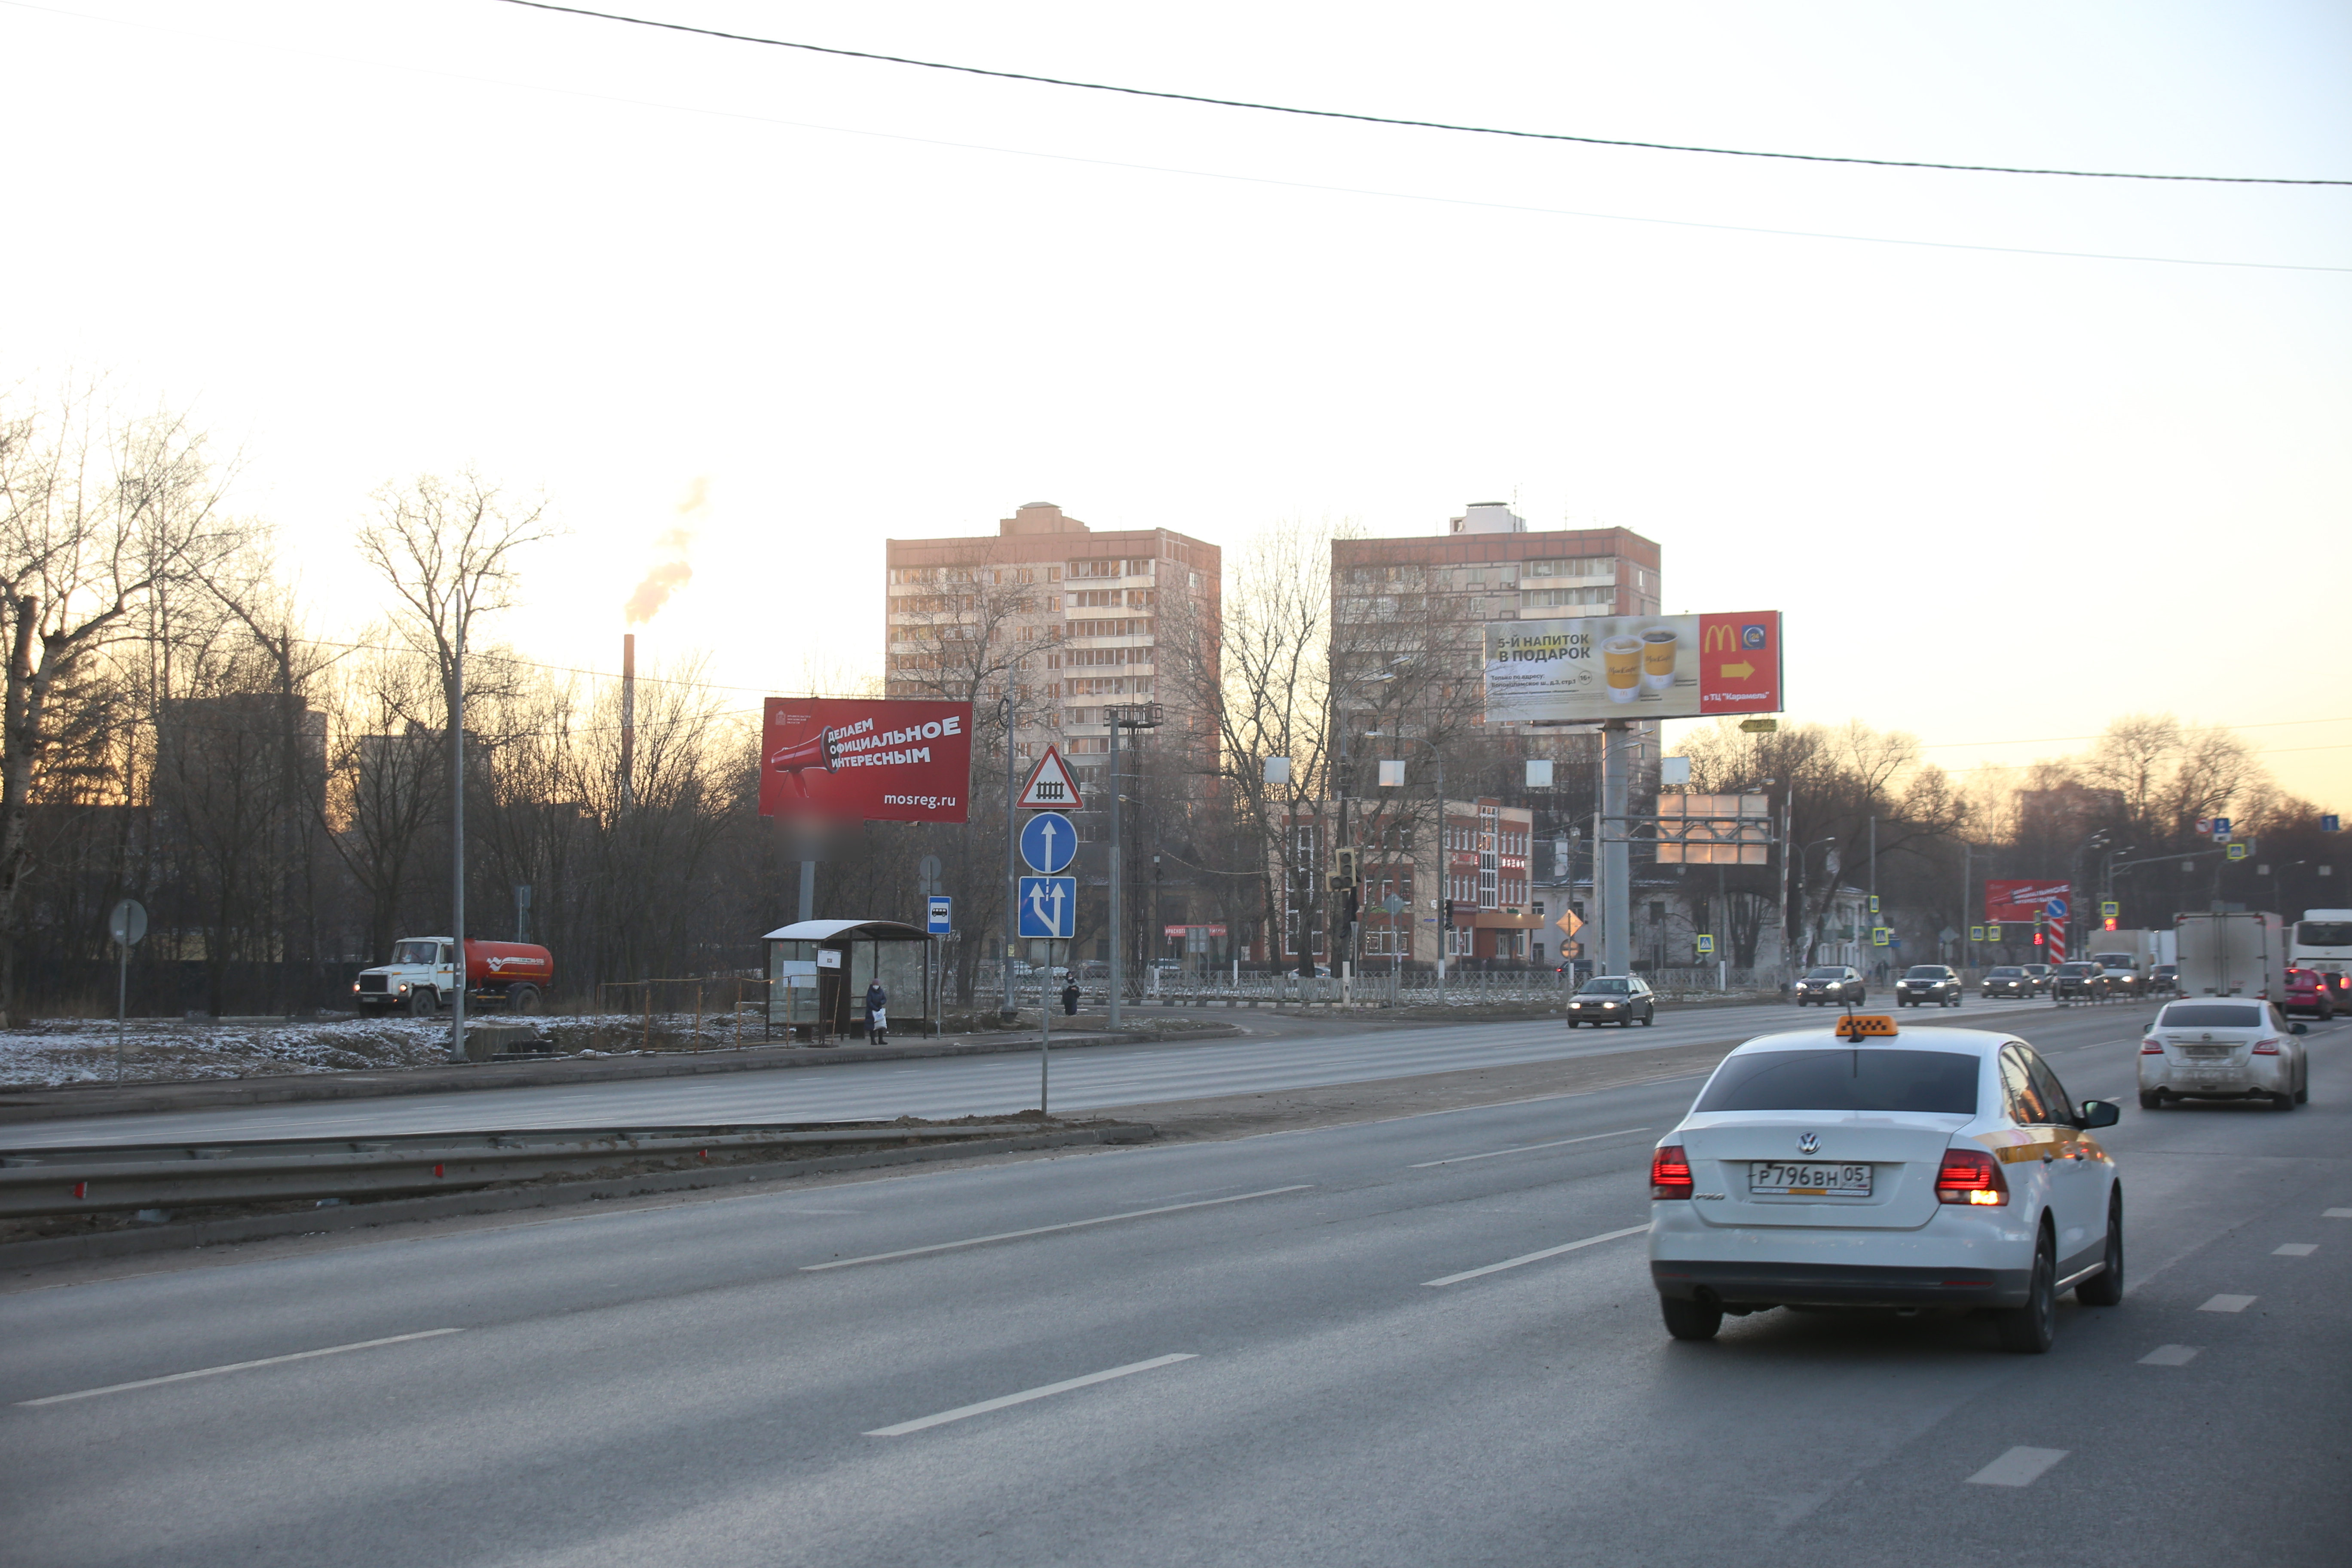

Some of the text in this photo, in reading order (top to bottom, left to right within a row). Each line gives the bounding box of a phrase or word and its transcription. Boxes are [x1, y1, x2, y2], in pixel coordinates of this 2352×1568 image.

[1498, 634, 1589, 648] 5-Й НАПИТОК
[1500, 647, 1591, 663] В ПОДАРОК
[1722, 691, 1769, 701] "Карамель"
[828, 717, 873, 743] ДЕЛАЕМ
[830, 716, 961, 755] ОФИЦИАЛЬНОЕ
[832, 747, 931, 768] ИНТЕРЕСНЫМ
[884, 794, 956, 809] mosreg.ru
[1844, 1167, 1864, 1182] 05
